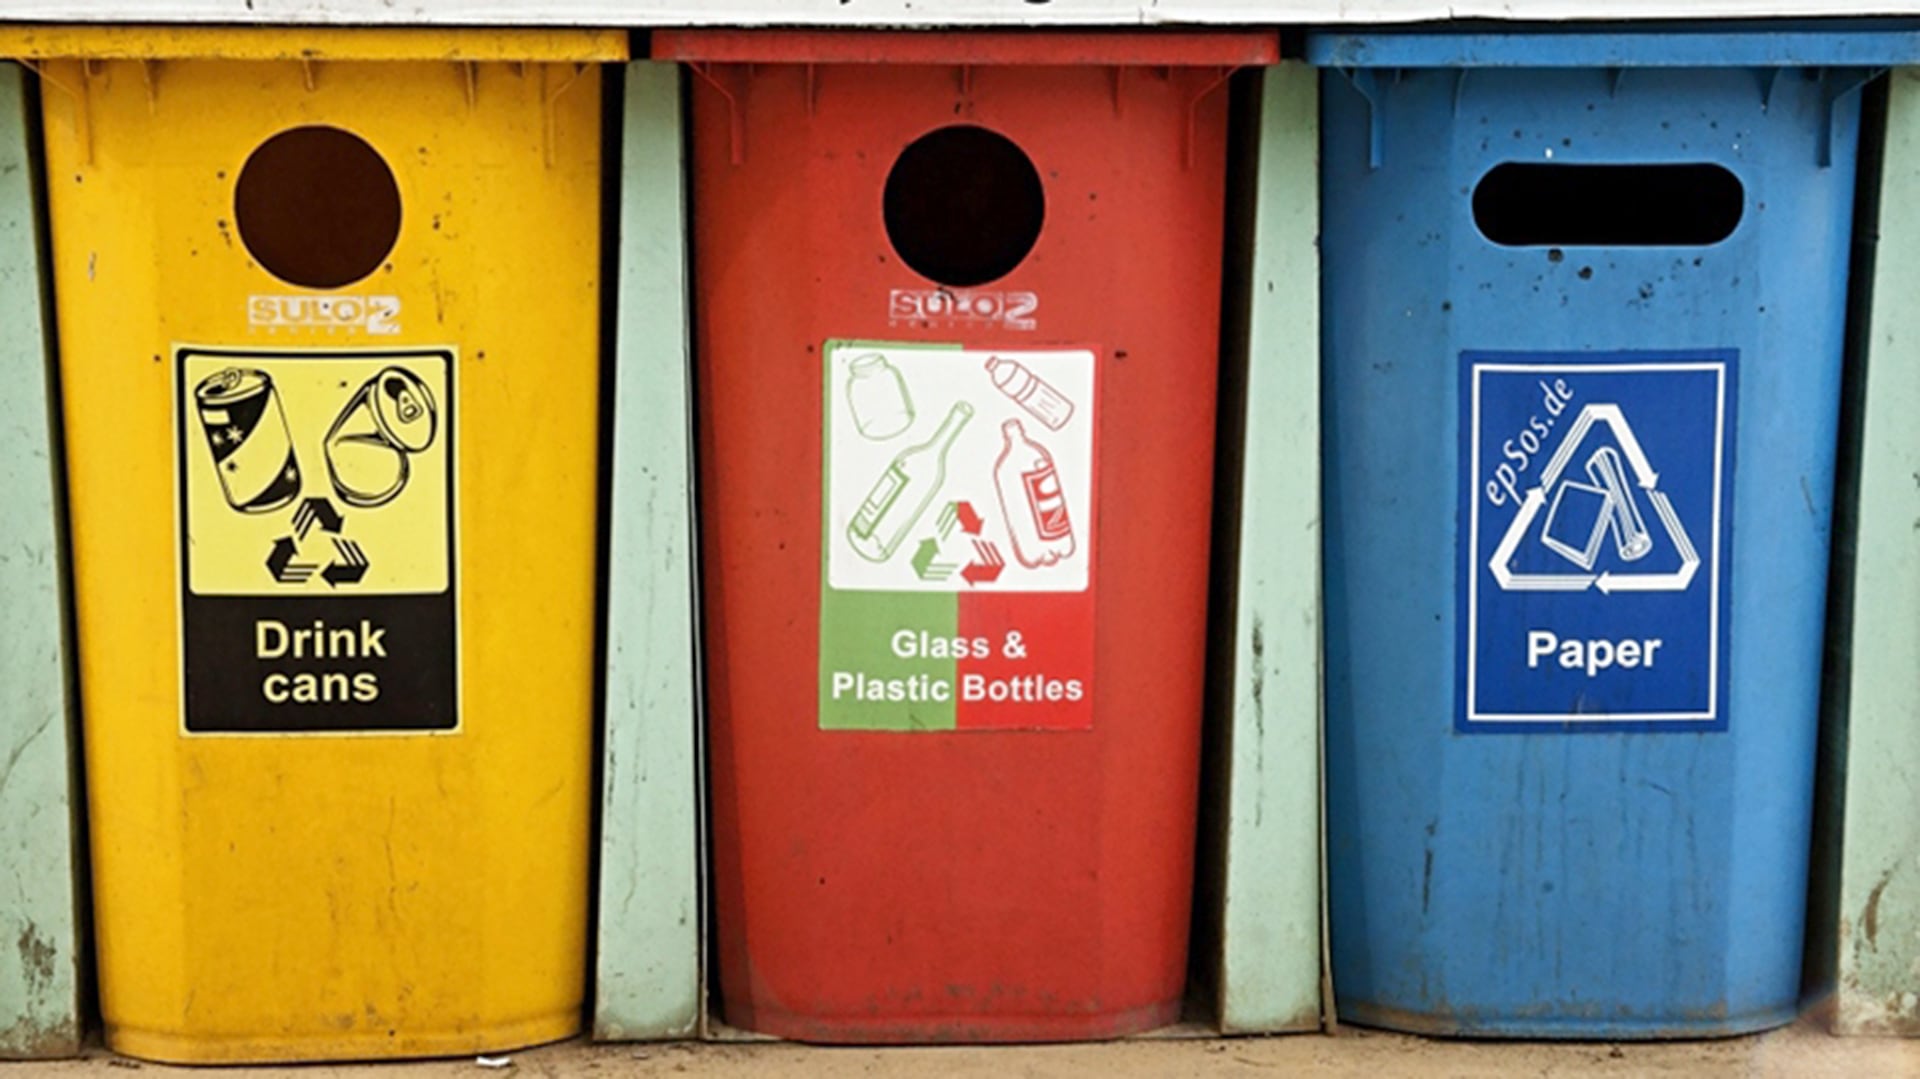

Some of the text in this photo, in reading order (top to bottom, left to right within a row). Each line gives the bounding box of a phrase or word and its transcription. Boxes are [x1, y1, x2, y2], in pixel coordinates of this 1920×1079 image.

[256, 620, 386, 658] Drink
[890, 629, 1027, 659] Glass &
[1528, 631, 1662, 677] Paper
[263, 672, 378, 703] cans
[832, 671, 1083, 702] Plastic Bottles
